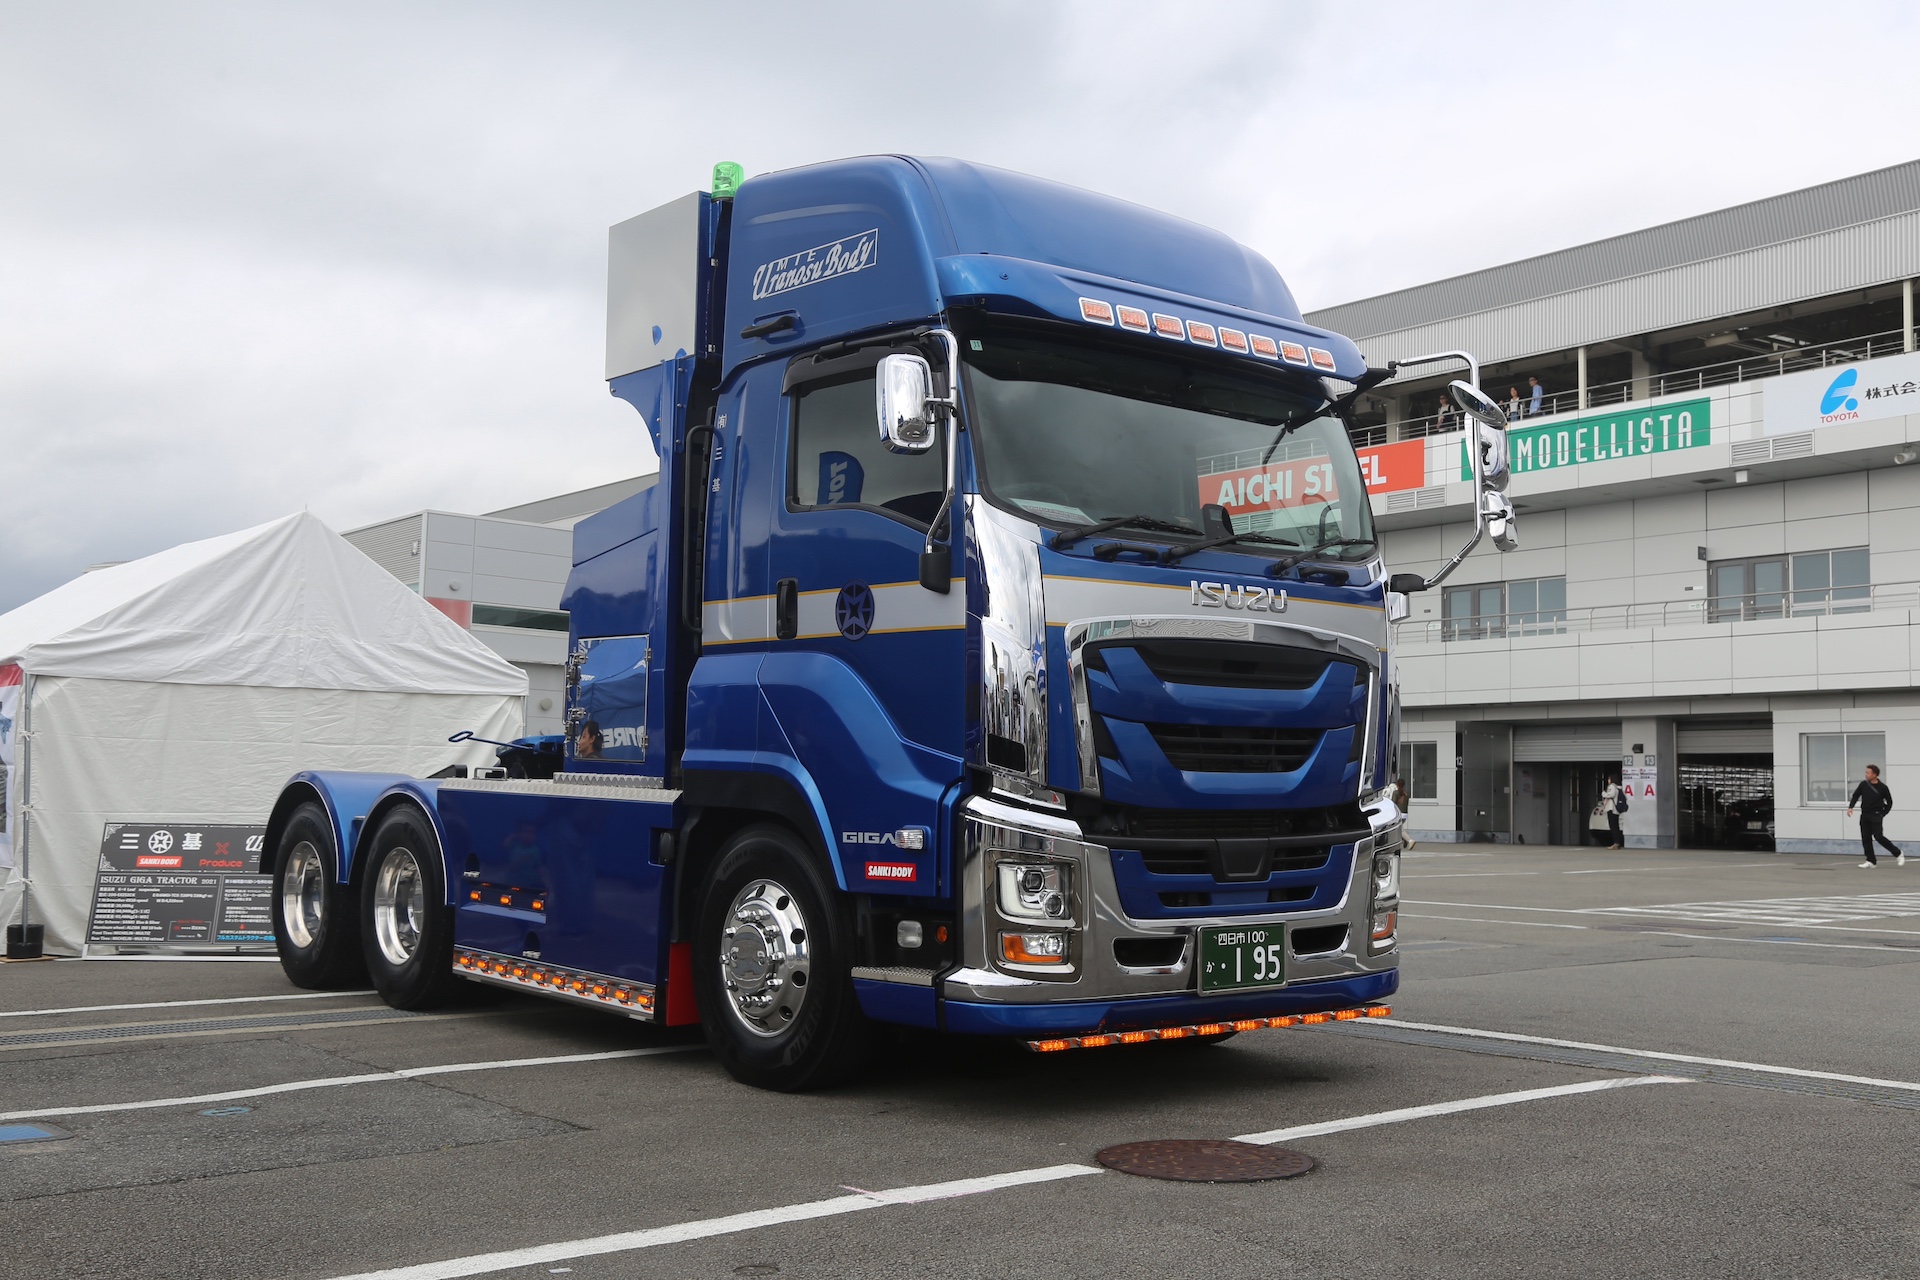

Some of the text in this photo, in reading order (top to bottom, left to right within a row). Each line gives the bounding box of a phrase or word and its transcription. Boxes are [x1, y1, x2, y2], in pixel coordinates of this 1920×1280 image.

[823, 236, 875, 278] Body
[1864, 381, 1920, 400] 株式会
[1820, 411, 1859, 423] TOYOTA
[1517, 411, 1692, 472] MODELLISTA
[1216, 454, 1387, 507] AICHI STEL
[1190, 580, 1288, 613] ISUZU
[1624, 756, 1633, 765] 12
[1645, 756, 1655, 765] 13
[1624, 784, 1634, 796] A
[1644, 784, 1654, 796] A
[842, 831, 897, 845] GIGA
[199, 859, 243, 868] Produce
[867, 865, 914, 878] SANKI BODY
[100, 875, 127, 884] ISUZU
[130, 876, 153, 884] GIGA
[157, 876, 198, 885] TRACTOR
[1218, 930, 1265, 945] 四日市 100
[1206, 961, 1215, 973] か
